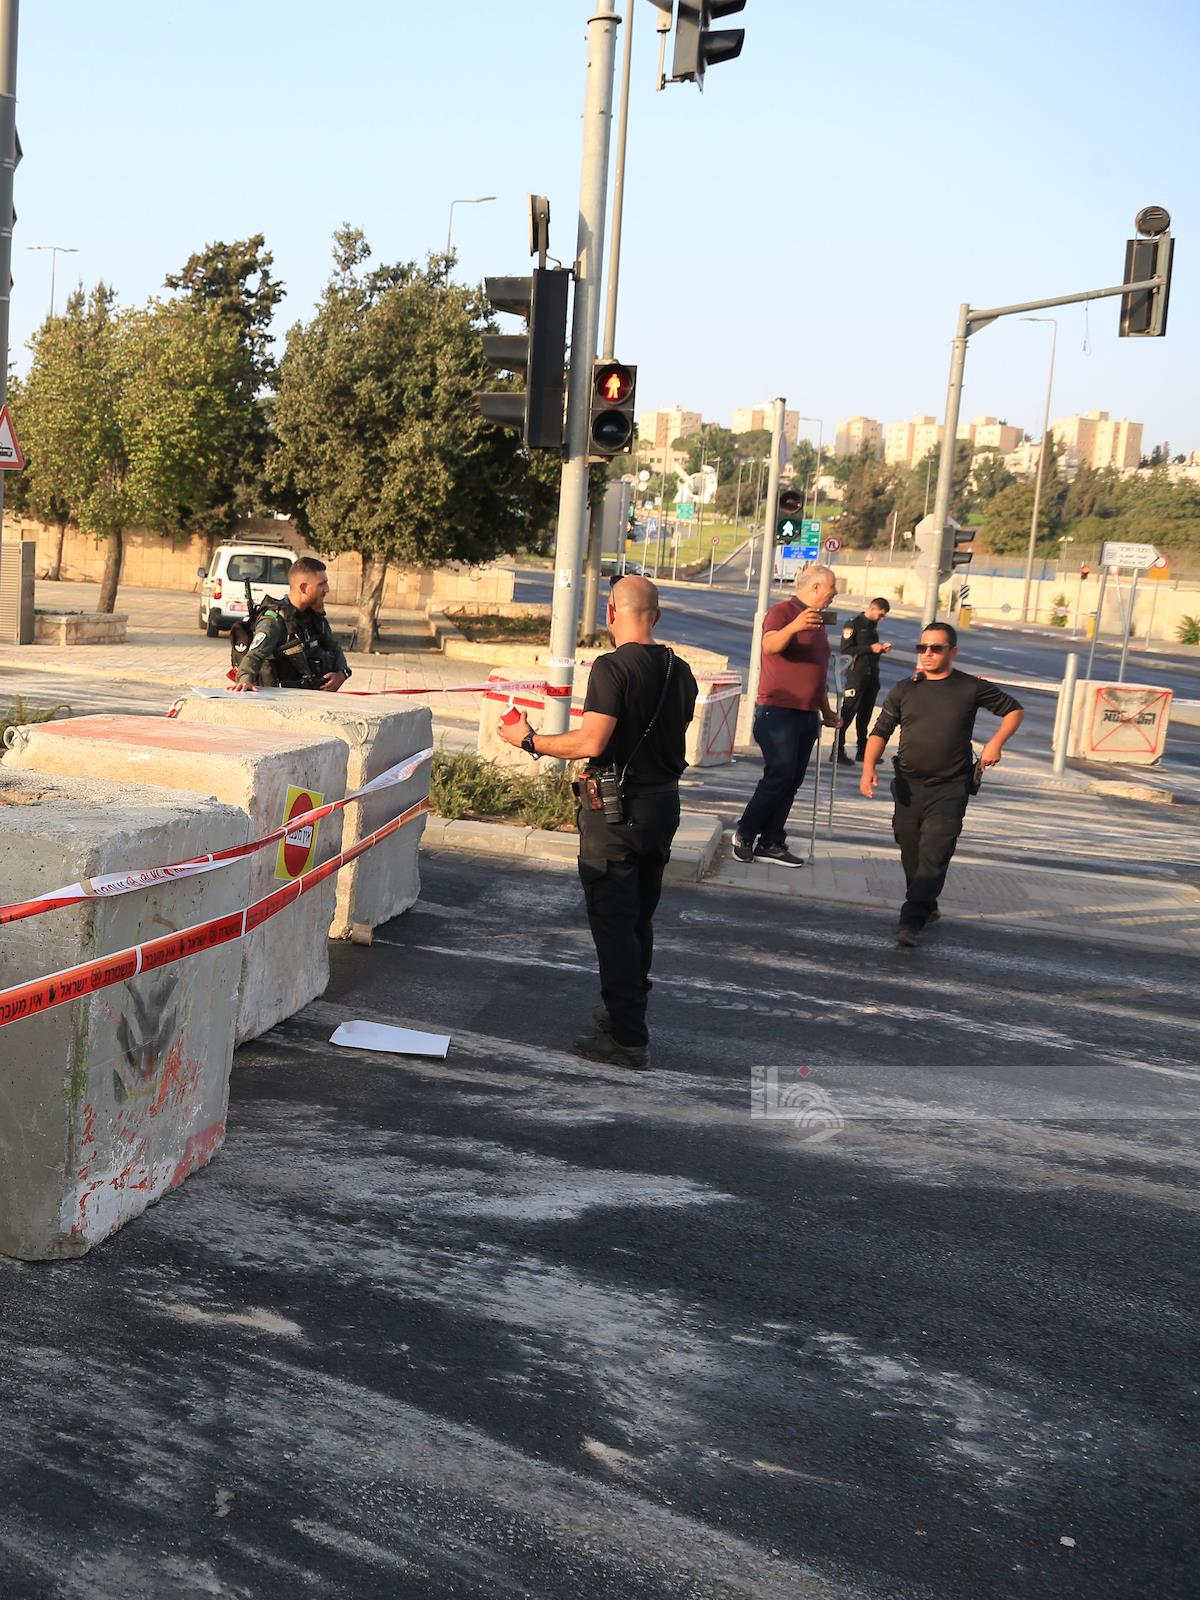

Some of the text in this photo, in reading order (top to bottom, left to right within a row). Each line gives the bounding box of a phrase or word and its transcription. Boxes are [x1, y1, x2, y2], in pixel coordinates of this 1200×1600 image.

[60, 978, 87, 996] ישראל
[0, 999, 26, 1021] מעבר
[29, 992, 43, 1011] אין
